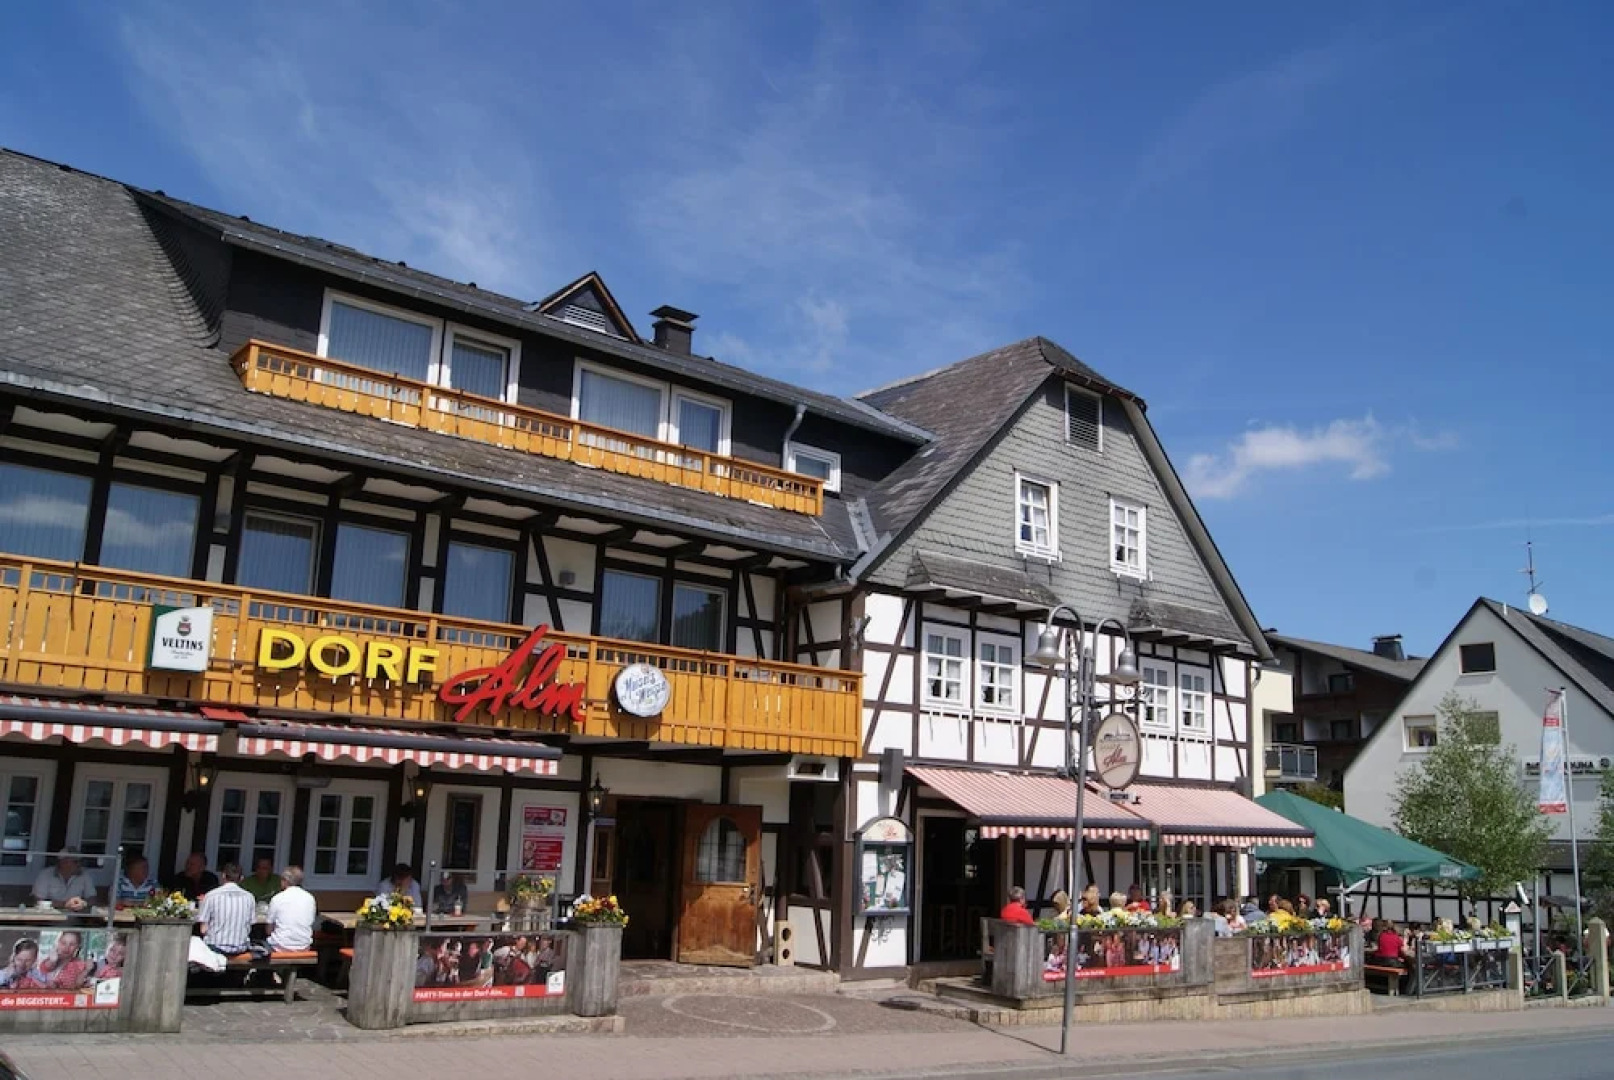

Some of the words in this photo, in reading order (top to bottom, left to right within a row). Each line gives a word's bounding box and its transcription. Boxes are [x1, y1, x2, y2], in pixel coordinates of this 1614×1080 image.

[162, 636, 204, 651] VELTINS
[258, 627, 439, 684] DORF
[439, 623, 587, 722] Alm
